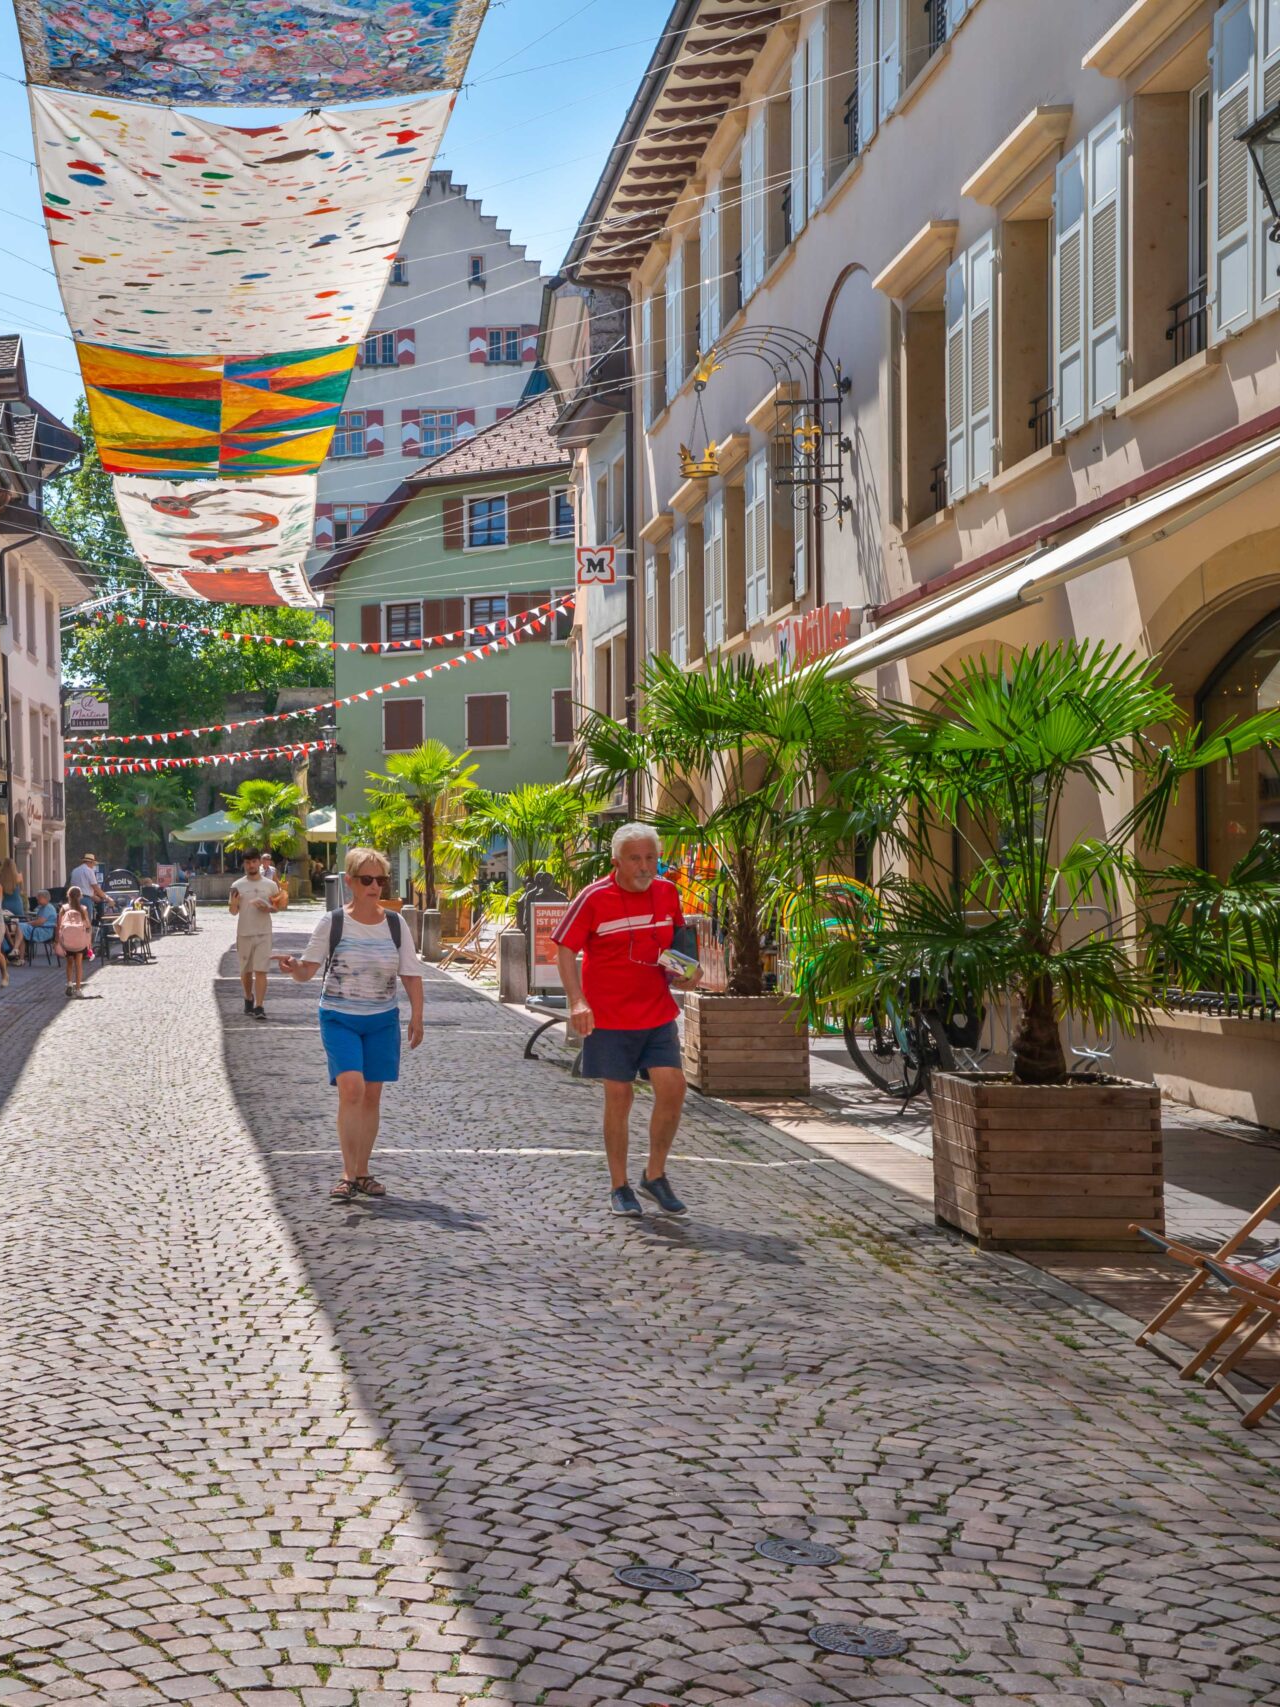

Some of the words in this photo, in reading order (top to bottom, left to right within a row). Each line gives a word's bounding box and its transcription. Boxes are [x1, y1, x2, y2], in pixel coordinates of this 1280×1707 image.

[586, 557, 606, 574] M
[793, 602, 851, 672] Müller
[72, 709, 106, 718] Martino
